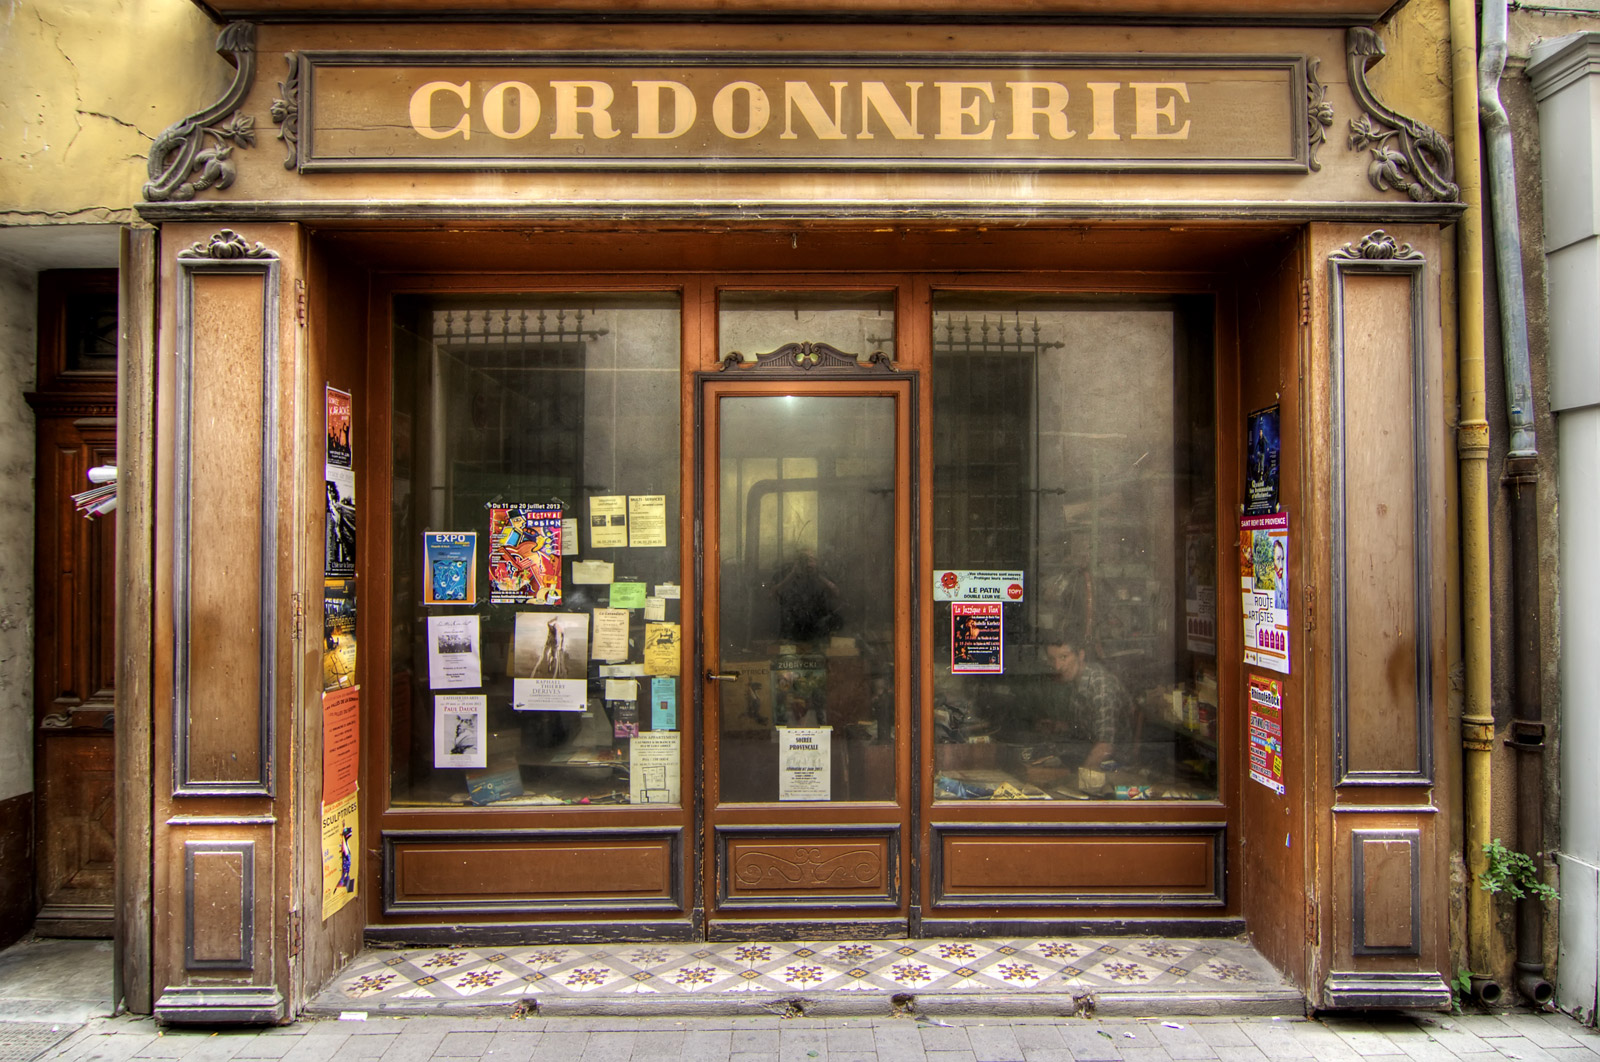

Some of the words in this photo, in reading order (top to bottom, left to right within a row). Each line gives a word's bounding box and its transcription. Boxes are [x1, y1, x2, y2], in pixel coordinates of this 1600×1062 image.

[408, 80, 1192, 141] CORDONNERIE
[1264, 517, 1286, 525] PROVENCE
[435, 534, 466, 542] EXPO
[1254, 596, 1274, 608] ROUTE
[1248, 610, 1274, 623] ARTISTES
[322, 802, 357, 828] SCULPTRICES
